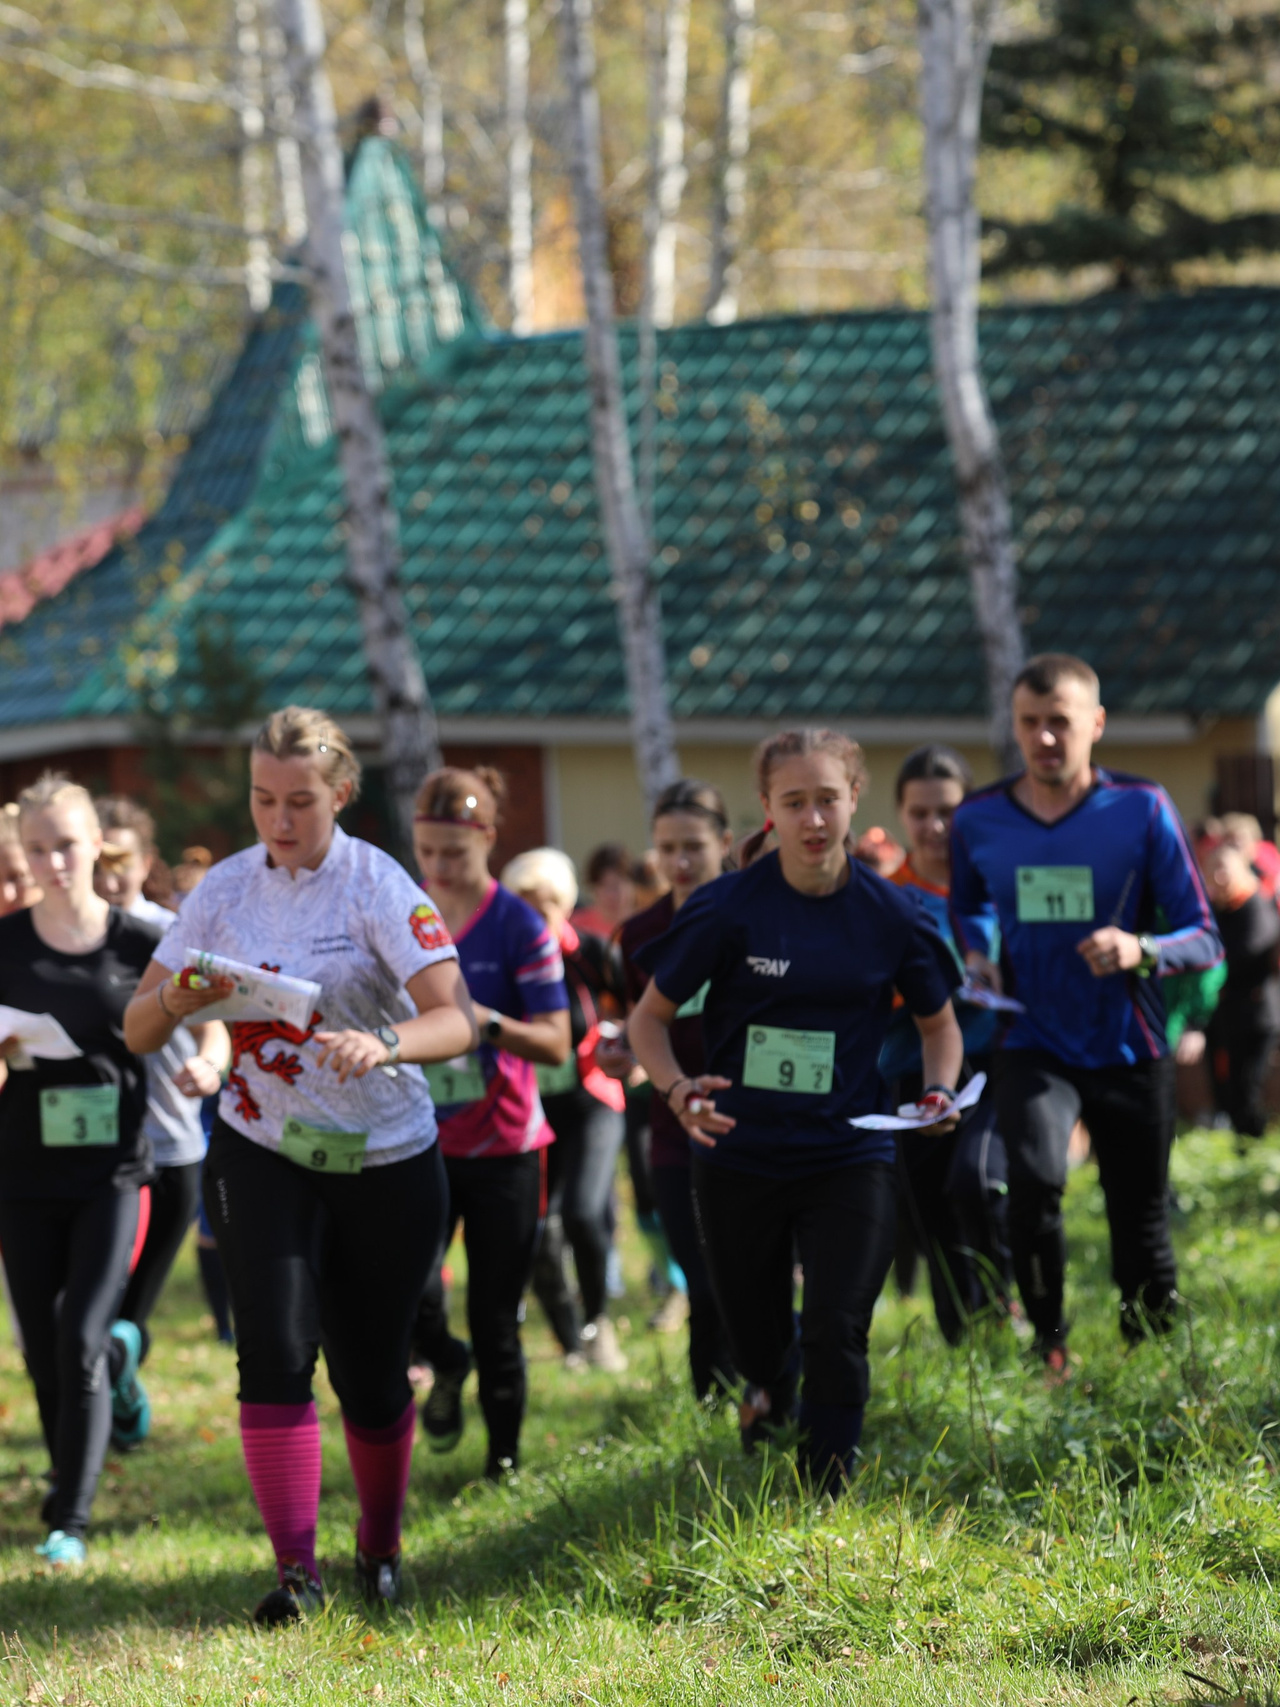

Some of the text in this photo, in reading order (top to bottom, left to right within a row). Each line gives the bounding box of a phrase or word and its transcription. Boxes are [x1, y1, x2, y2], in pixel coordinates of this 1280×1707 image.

[1045, 894, 1066, 919] 11
[779, 1060, 796, 1088] 9
[73, 1114, 88, 1140] 3
[311, 1149, 328, 1169] 9
